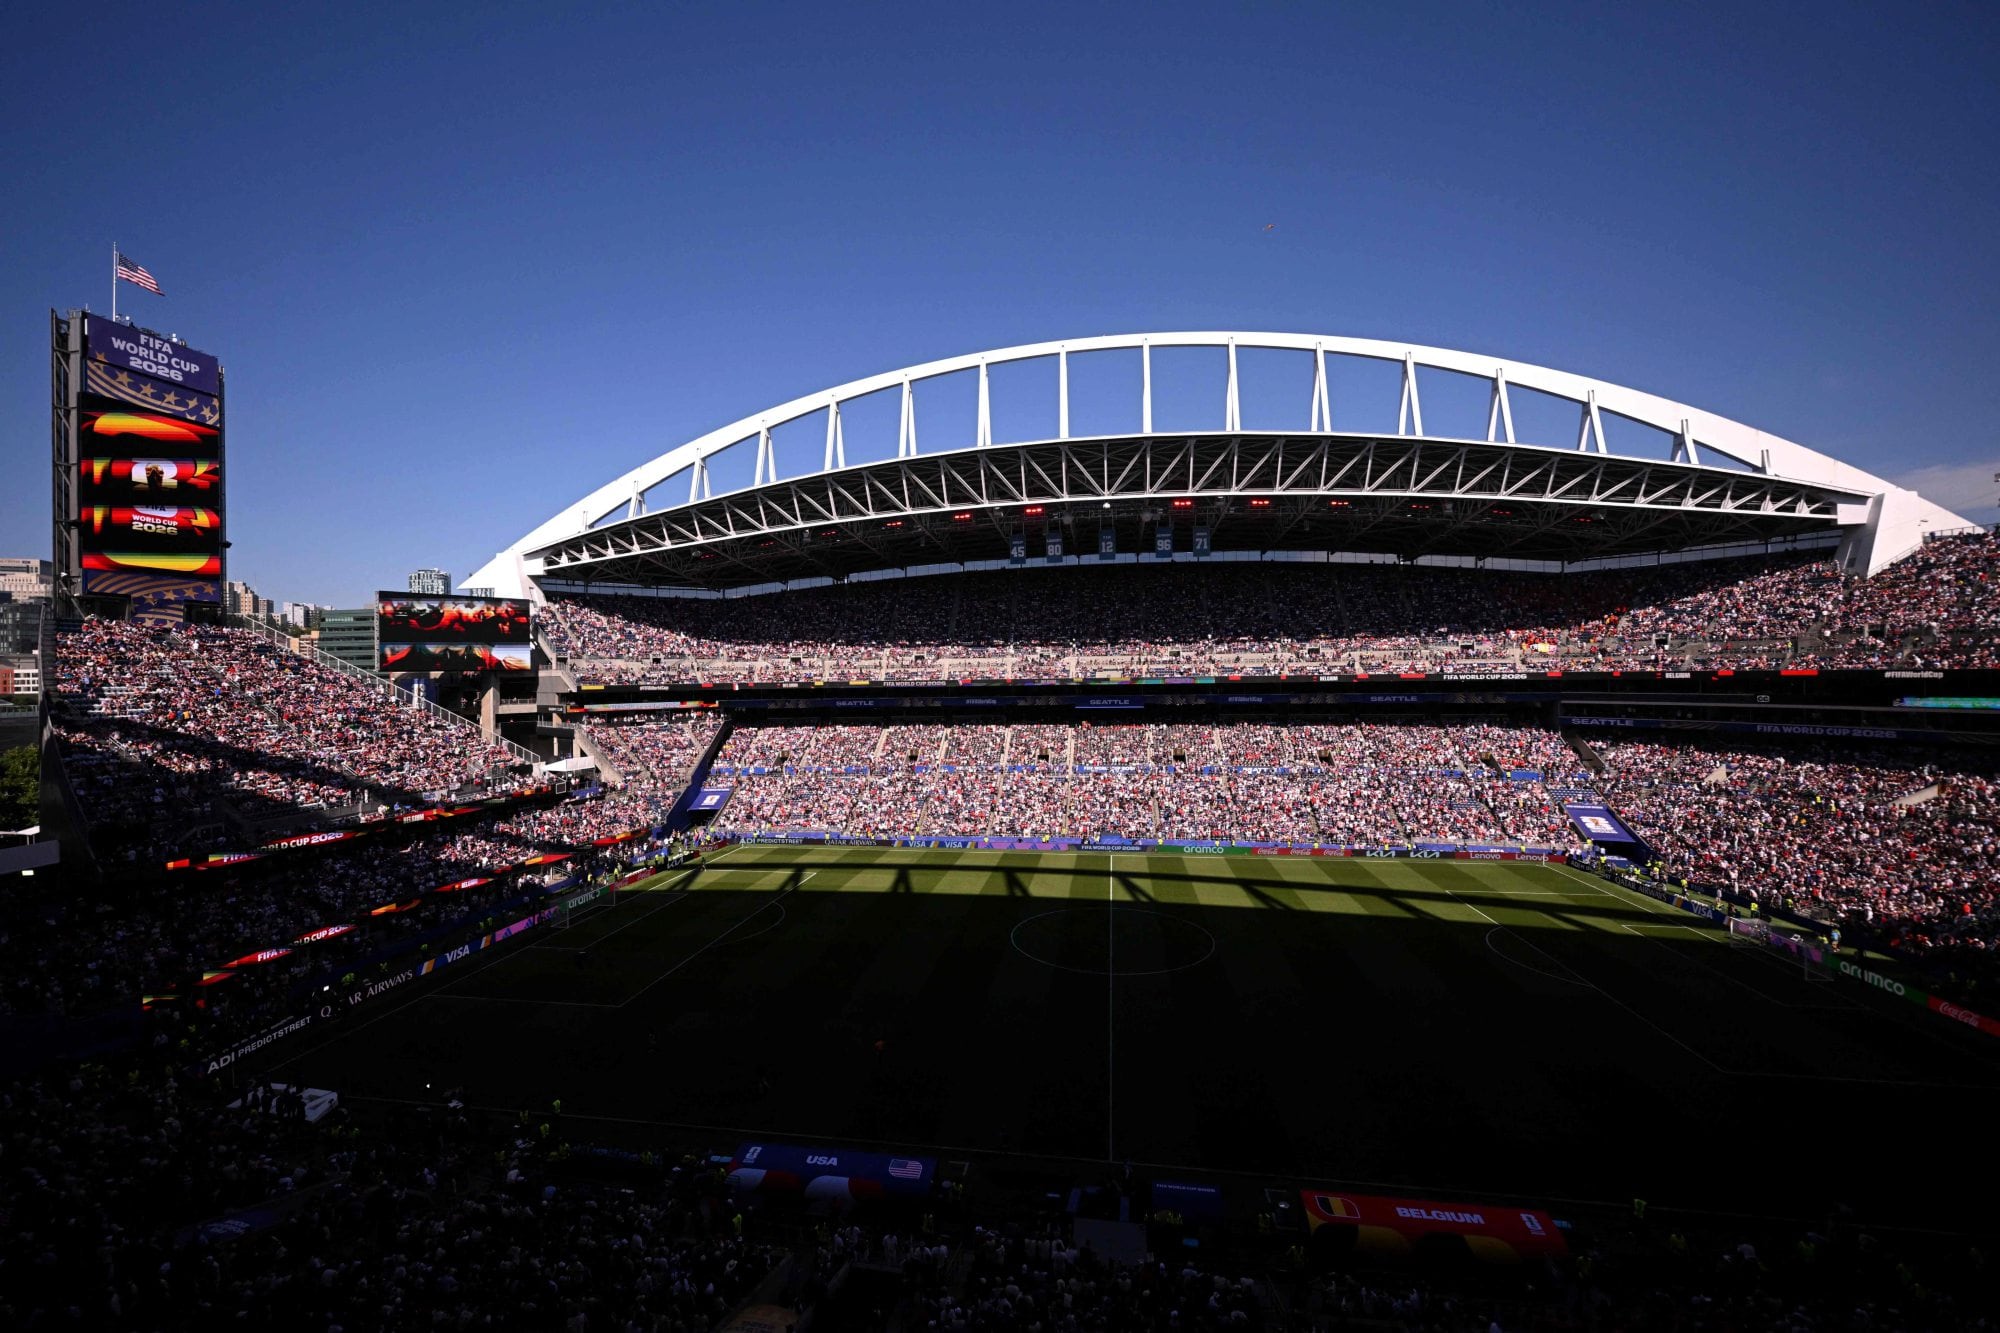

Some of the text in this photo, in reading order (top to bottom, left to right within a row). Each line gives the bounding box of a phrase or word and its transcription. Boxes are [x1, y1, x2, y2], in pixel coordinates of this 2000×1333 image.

[140, 334, 173, 354] FIFA
[112, 337, 200, 374] WORLD CUP
[129, 356, 184, 382] 2026
[132, 514, 178, 527] WORLD CUP
[132, 521, 178, 535] 2026
[1101, 541, 1114, 553] 12
[1157, 539, 1172, 551] 96
[1195, 538, 1208, 550] 71
[1011, 546, 1025, 558] 45
[1571, 718, 1634, 727] SEATTLE
[1756, 725, 1897, 739] FIFA WORLD CUP 2026
[289, 837, 309, 848] CUP
[1183, 845, 1224, 854] aramco
[1470, 852, 1501, 860] Lenovo
[1515, 853, 1549, 862] Lenovo
[1691, 901, 1714, 920] VISA
[257, 948, 278, 962] FIFA
[311, 930, 328, 942] CUP
[444, 944, 471, 963] VISA
[366, 969, 413, 998] AIRWAYS
[1839, 960, 1905, 996] aramco
[207, 1015, 312, 1074] ADI PREDICTSTREET
[806, 1155, 839, 1167] USA
[1395, 1206, 1486, 1225] BELGIUM
